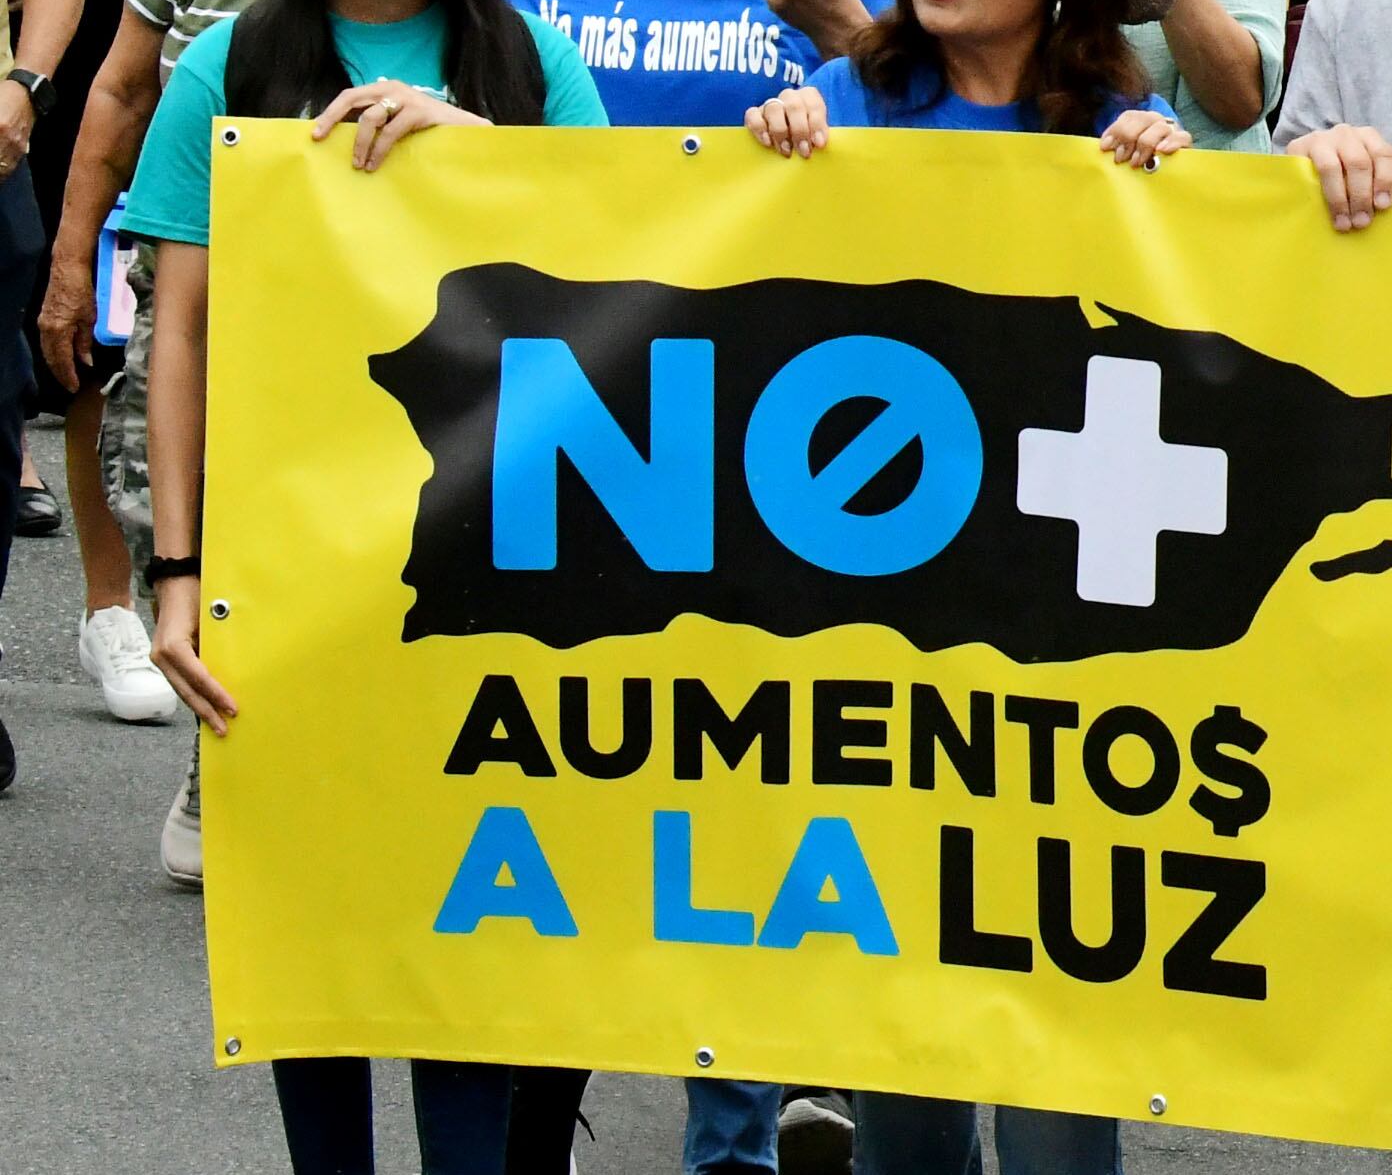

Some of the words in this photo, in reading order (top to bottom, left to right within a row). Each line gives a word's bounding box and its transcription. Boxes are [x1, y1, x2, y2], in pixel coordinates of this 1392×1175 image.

[578, 1, 638, 71] más
[644, 7, 780, 78] aumentos
[444, 674, 1271, 837] AUMENTO$
[433, 806, 579, 938] A
[651, 810, 899, 957] LA
[939, 826, 1267, 1002] LUZ
